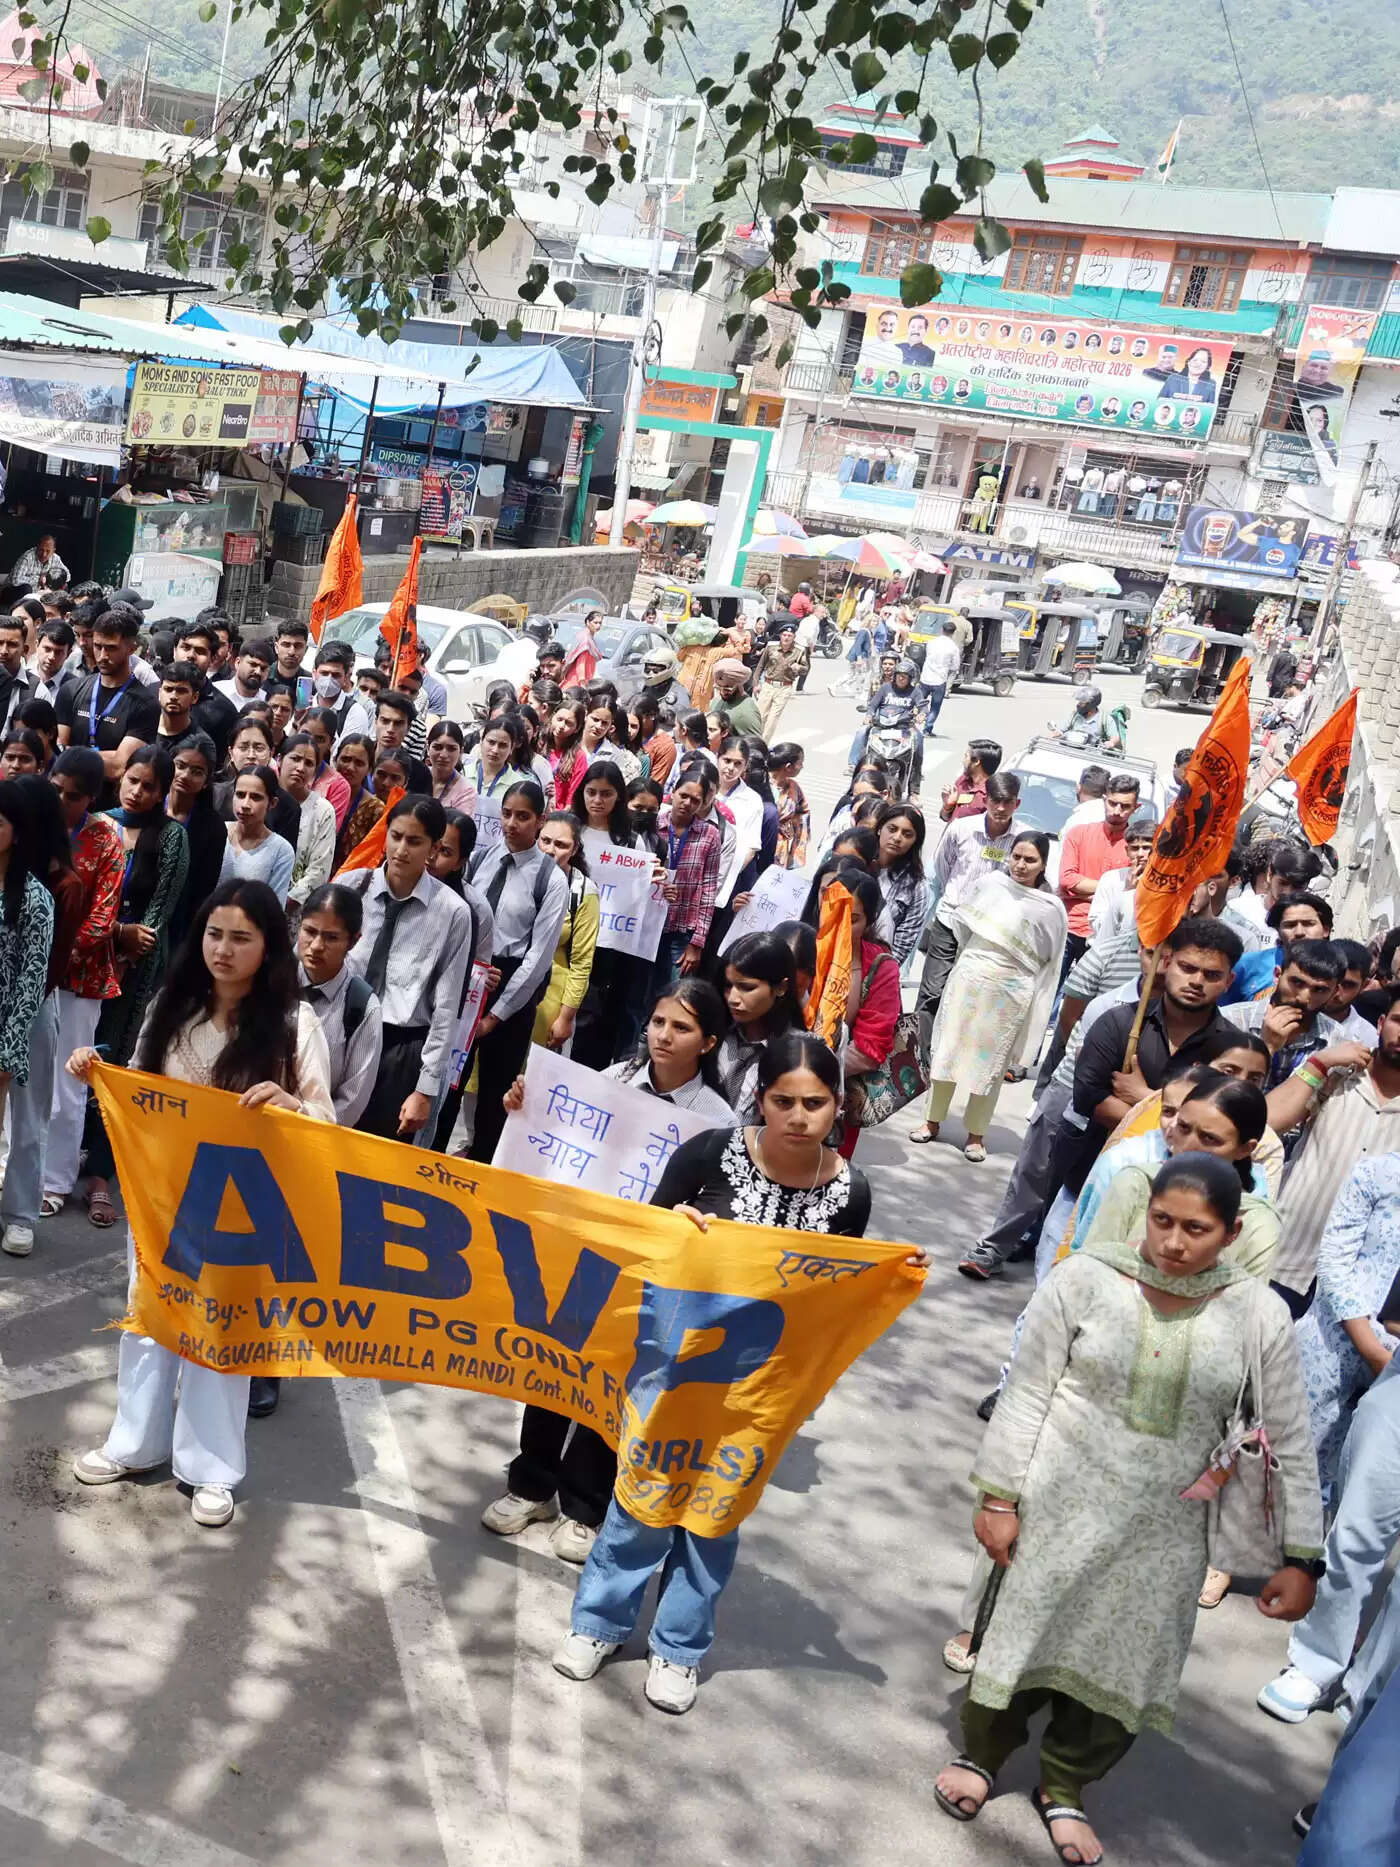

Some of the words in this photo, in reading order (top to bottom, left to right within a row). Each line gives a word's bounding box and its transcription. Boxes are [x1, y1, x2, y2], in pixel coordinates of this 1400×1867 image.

[141, 368, 171, 381] MOM'S
[171, 369, 189, 382] AND
[190, 371, 213, 385] SONS
[214, 373, 235, 386] FAST
[236, 374, 259, 388] FOOD
[970, 364, 985, 377] की
[987, 367, 1021, 381] हार्दिक
[1061, 355, 1105, 375] महोत्सव
[1108, 360, 1132, 377] 2026
[143, 381, 195, 394] SPECIALISTS
[224, 387, 248, 398] TIKKI
[222, 414, 248, 425] NearBro
[378, 449, 420, 465] DIPSOME
[951, 545, 1030, 569] ATM
[131, 1086, 189, 1119] ज्ञान
[547, 1084, 615, 1142] सिया
[528, 1131, 599, 1179] न्याय
[415, 1162, 481, 1196] शील
[161, 1141, 787, 1424] ABVP
[254, 1296, 377, 1331] WOW
[408, 1307, 478, 1346] PG
[494, 1327, 596, 1384] (ONLY
[324, 1338, 435, 1372] MUHALLA
[446, 1351, 516, 1386] MANDI
[523, 1368, 566, 1404] Cont.
[571, 1385, 599, 1419] No.
[626, 1438, 766, 1489] GIRLS)
